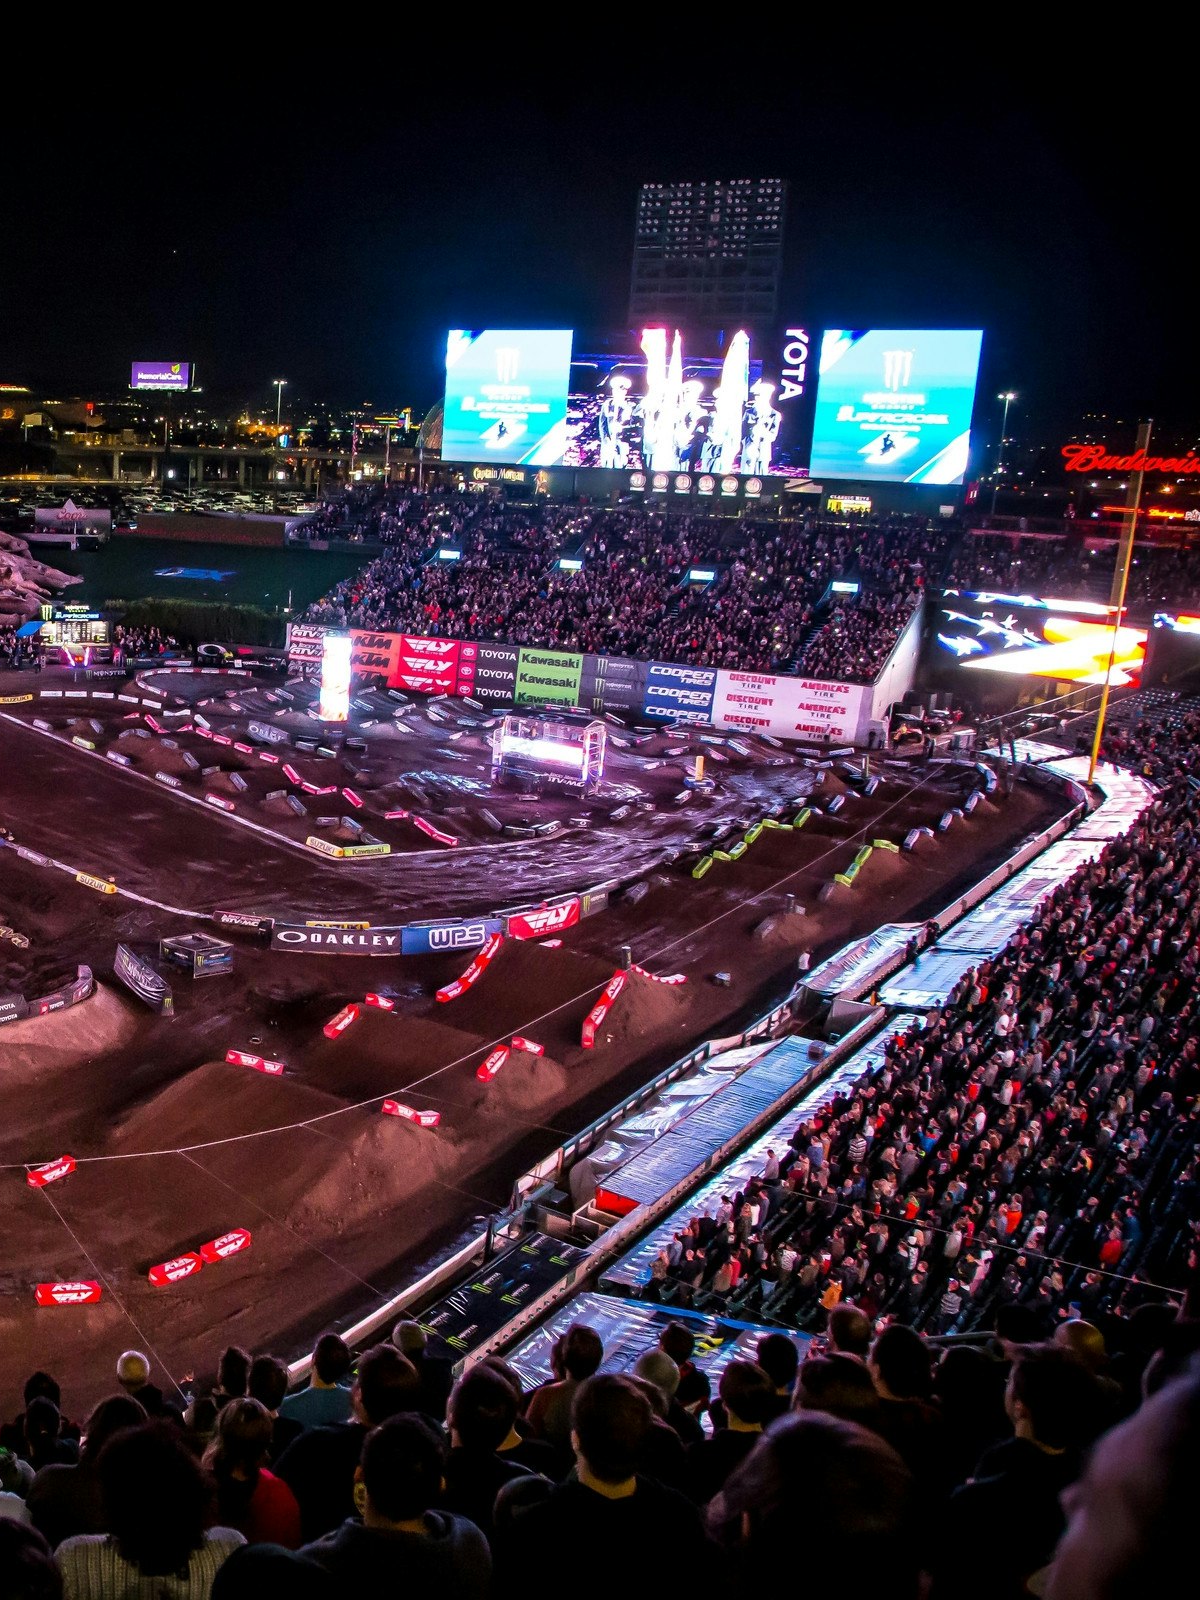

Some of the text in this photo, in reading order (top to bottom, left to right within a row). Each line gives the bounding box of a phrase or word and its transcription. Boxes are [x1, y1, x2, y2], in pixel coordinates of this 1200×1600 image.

[473, 467, 525, 482] Captain Morgan
[352, 634, 393, 650] KTM
[404, 638, 456, 653] FLY
[351, 652, 390, 668] KTM
[480, 650, 517, 661] TOYOTA
[522, 653, 580, 669] Kawasaki
[402, 656, 454, 672] FLY
[477, 668, 514, 680] TOYOTA
[519, 672, 577, 688] Kawasaki
[650, 666, 715, 680] COOPER
[729, 672, 777, 686] DISCOUNT
[680, 677, 712, 686] TIRES
[801, 681, 849, 694] AMERICA'S
[475, 687, 513, 699] TOYOTA
[517, 692, 575, 707] Kawasaki
[647, 686, 712, 701] COOPER
[726, 693, 773, 706] DISCOUNT
[677, 697, 709, 707] TIRES
[739, 703, 759, 711] TIRE
[798, 702, 847, 715] AMERICA'S
[645, 706, 709, 721] COOPER
[723, 714, 771, 727] DISCOUNT
[309, 837, 335, 854] SUZUKI
[352, 847, 385, 856] Kawasaki
[79, 873, 107, 892] SUZUKI
[522, 904, 574, 930] FLY
[533, 923, 564, 935] RACING
[310, 933, 397, 946] OAKLEY
[429, 924, 486, 949] WPS
[49, 1001, 65, 1010] TOYOTA
[41, 1162, 72, 1182] FLY
[51, 1287, 93, 1302] FLY
